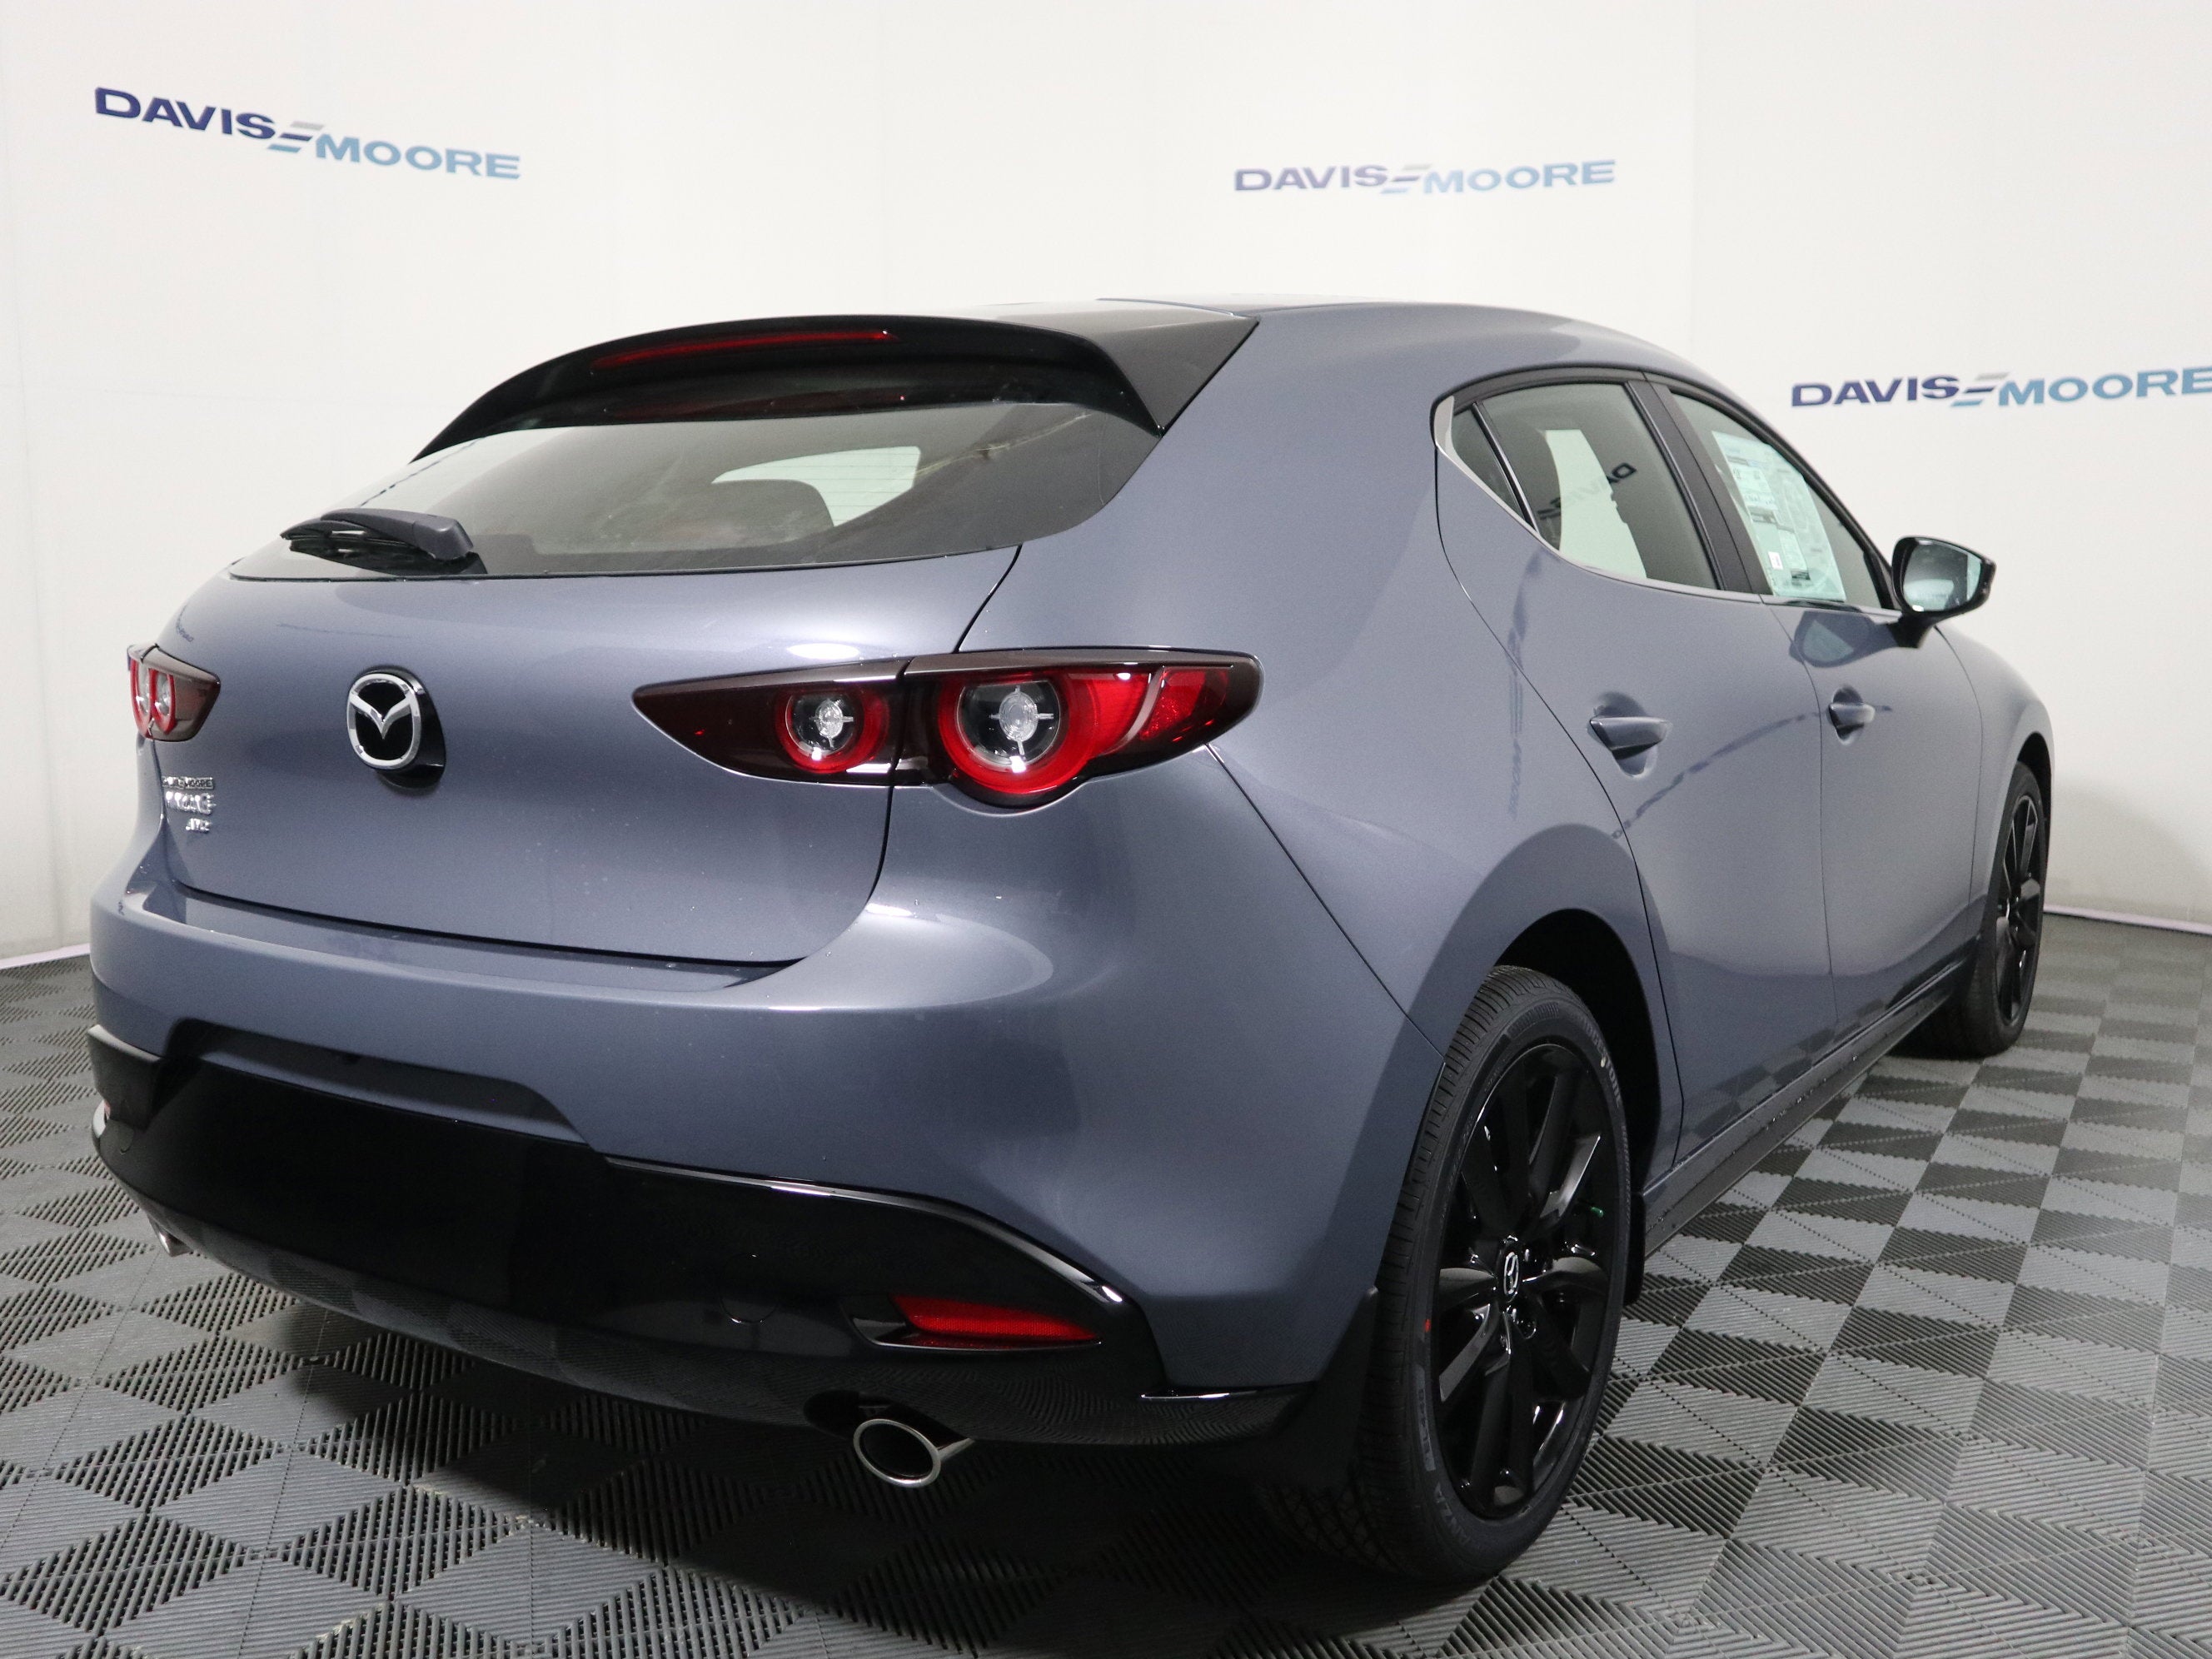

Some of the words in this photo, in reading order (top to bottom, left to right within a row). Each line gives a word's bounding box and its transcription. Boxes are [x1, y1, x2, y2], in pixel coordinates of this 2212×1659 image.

[93, 85, 277, 142] DAVIS
[314, 132, 521, 181] MOORE
[1233, 164, 1390, 193] DAVIS
[1422, 158, 1617, 195] MOORE
[1790, 373, 1961, 409] DAVIS
[1997, 364, 2212, 408] MOORE
